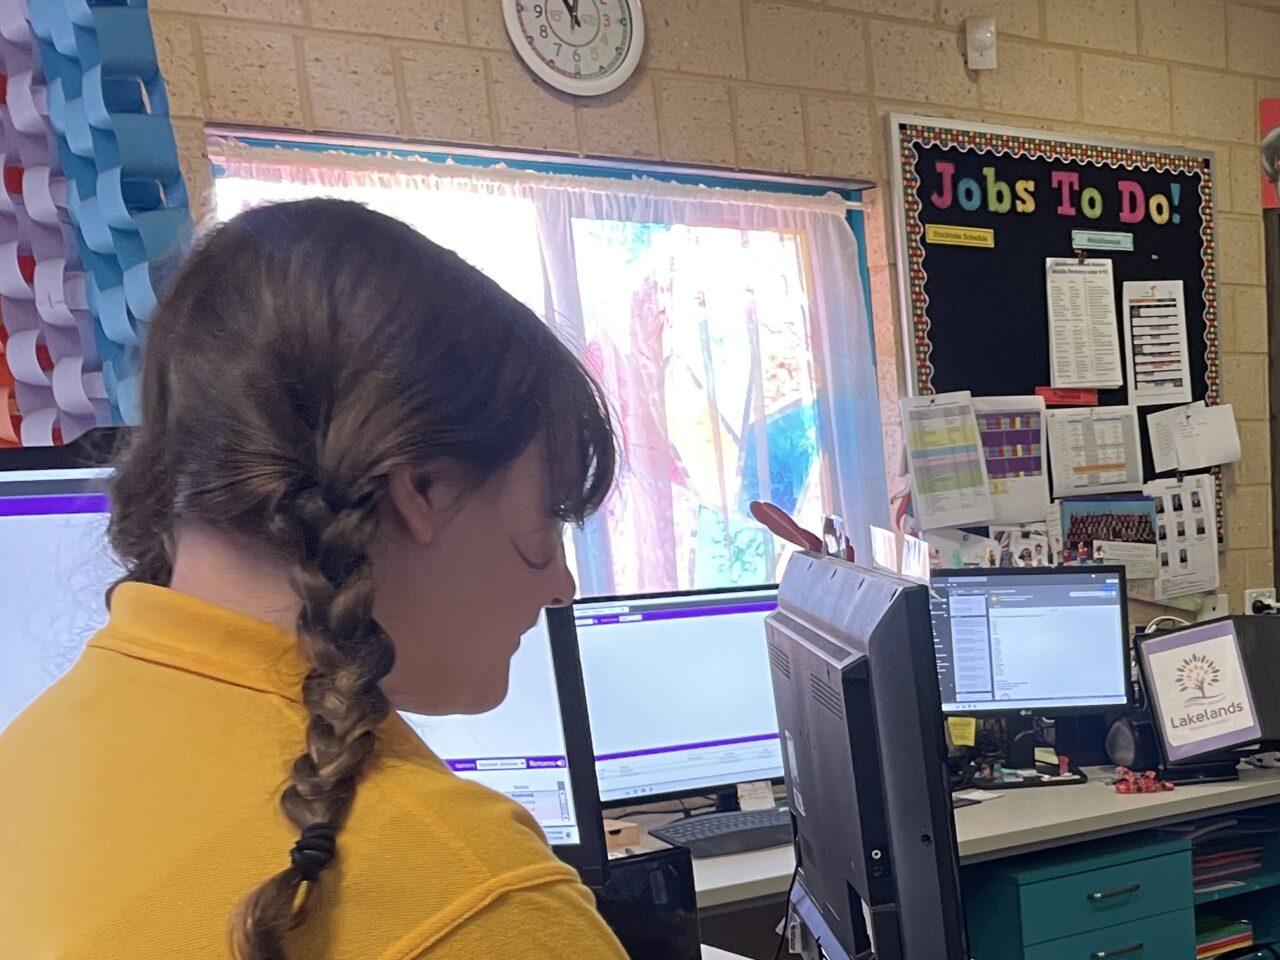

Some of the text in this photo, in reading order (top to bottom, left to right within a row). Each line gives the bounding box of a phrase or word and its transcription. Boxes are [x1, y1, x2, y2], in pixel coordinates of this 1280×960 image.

[533, 4, 543, 18] 9
[603, 13, 611, 28] 3
[540, 24, 549, 39] 8
[553, 42, 563, 57] 7
[573, 48, 581, 63] 6
[930, 162, 1182, 225] Jobs To Do!
[1170, 701, 1244, 729] Lakelands
